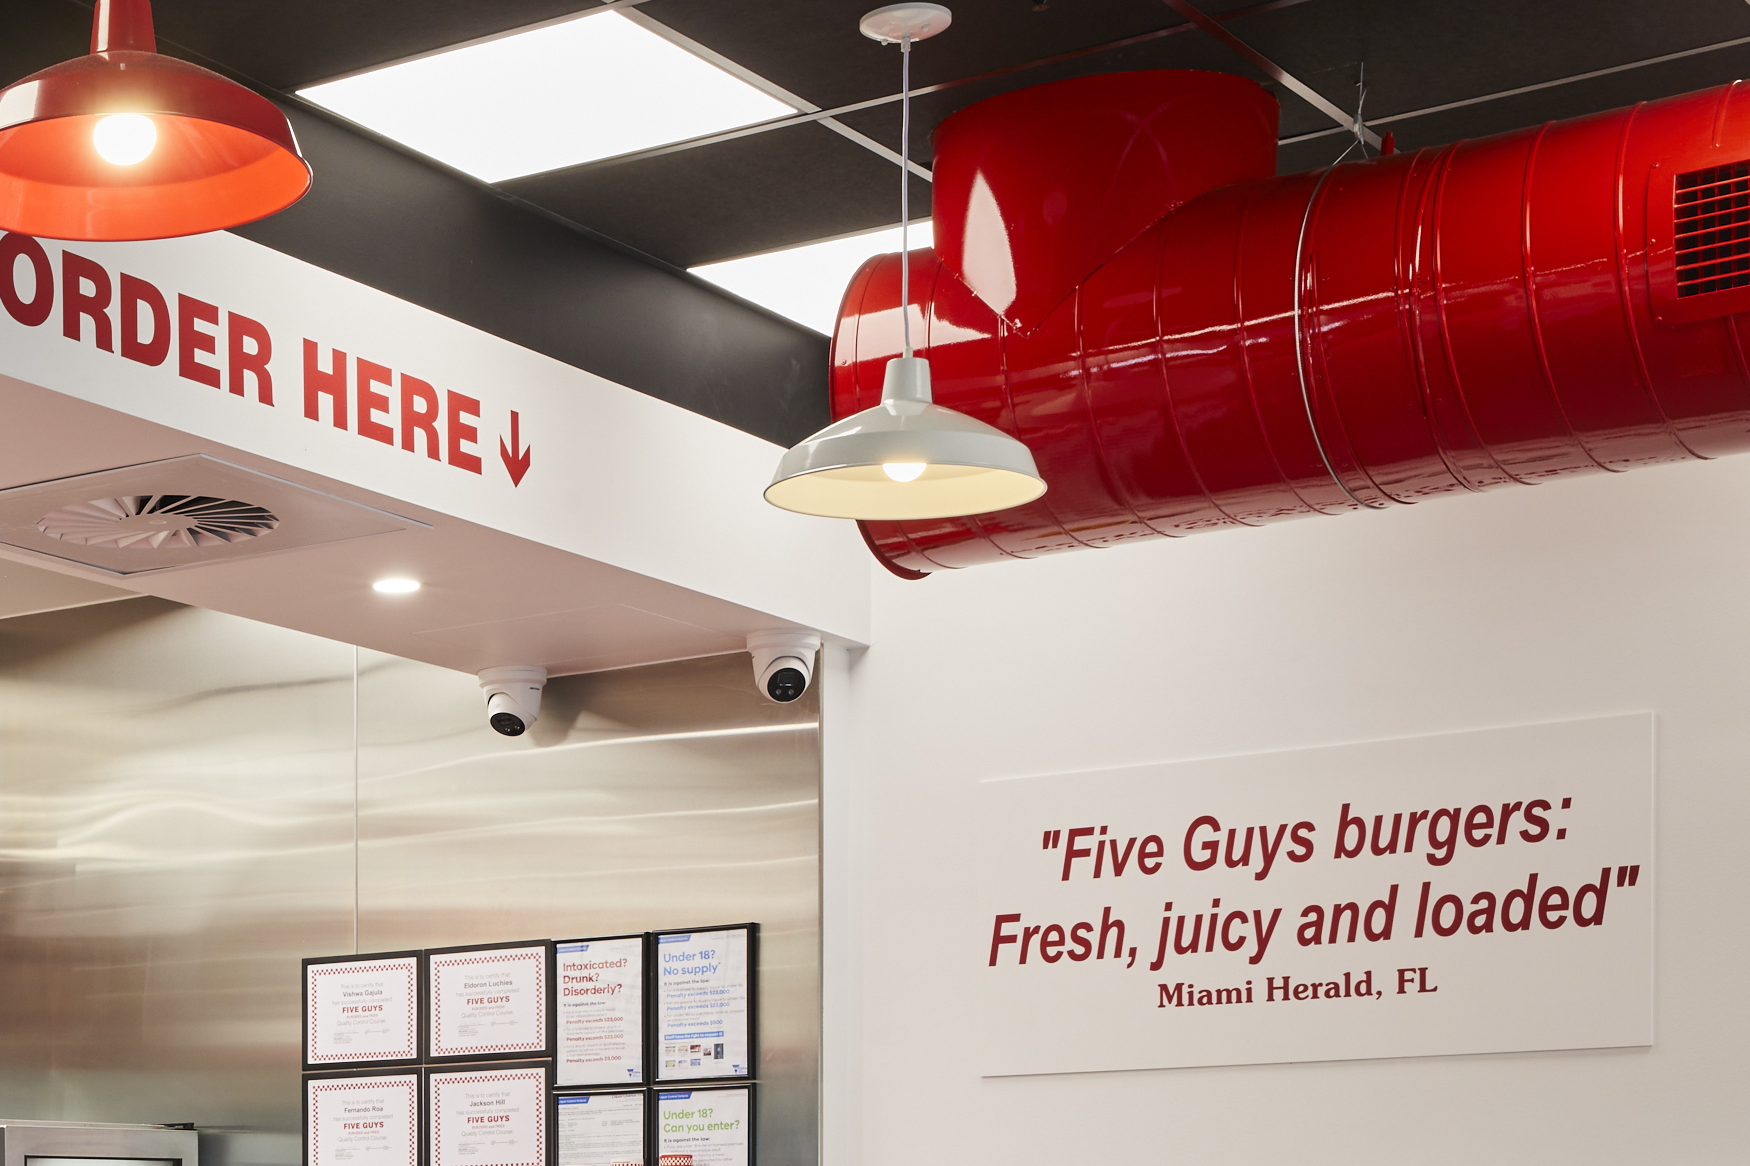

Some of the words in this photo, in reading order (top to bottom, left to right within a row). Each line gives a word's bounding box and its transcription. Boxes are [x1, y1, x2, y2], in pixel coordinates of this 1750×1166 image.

[303, 337, 482, 476] HERE
[1040, 826, 1164, 882] "Five
[1183, 815, 1317, 881] Guys
[1333, 797, 1573, 867] burgers:
[988, 906, 1140, 969] Fresh,
[1150, 898, 1282, 972] juicy
[1296, 884, 1399, 948] and
[1414, 864, 1641, 939] loaded"
[663, 951, 697, 963] Under
[698, 949, 716, 960] 18?
[563, 958, 628, 972] Intoxicated?
[663, 966, 679, 976] No
[563, 972, 600, 984] Drunk?
[563, 983, 623, 997] Disorderly?
[1158, 981, 1254, 1009] Miami
[1267, 970, 1384, 1003] Herald,
[1396, 966, 1439, 996] FL
[466, 997, 485, 1006] FIVE
[487, 995, 510, 1004] GUYS
[342, 1006, 361, 1014] FIVE
[362, 1004, 384, 1013] GUYS
[466, 1116, 486, 1124] FIVE
[487, 1114, 510, 1123] GUYS
[663, 1109, 696, 1120] Under
[697, 1108, 714, 1118] 18?
[343, 1122, 362, 1130] FIVE
[363, 1121, 384, 1129] GUYS
[663, 1123, 684, 1133] Can
[686, 1124, 705, 1134] you
[707, 1119, 740, 1131] enter?
